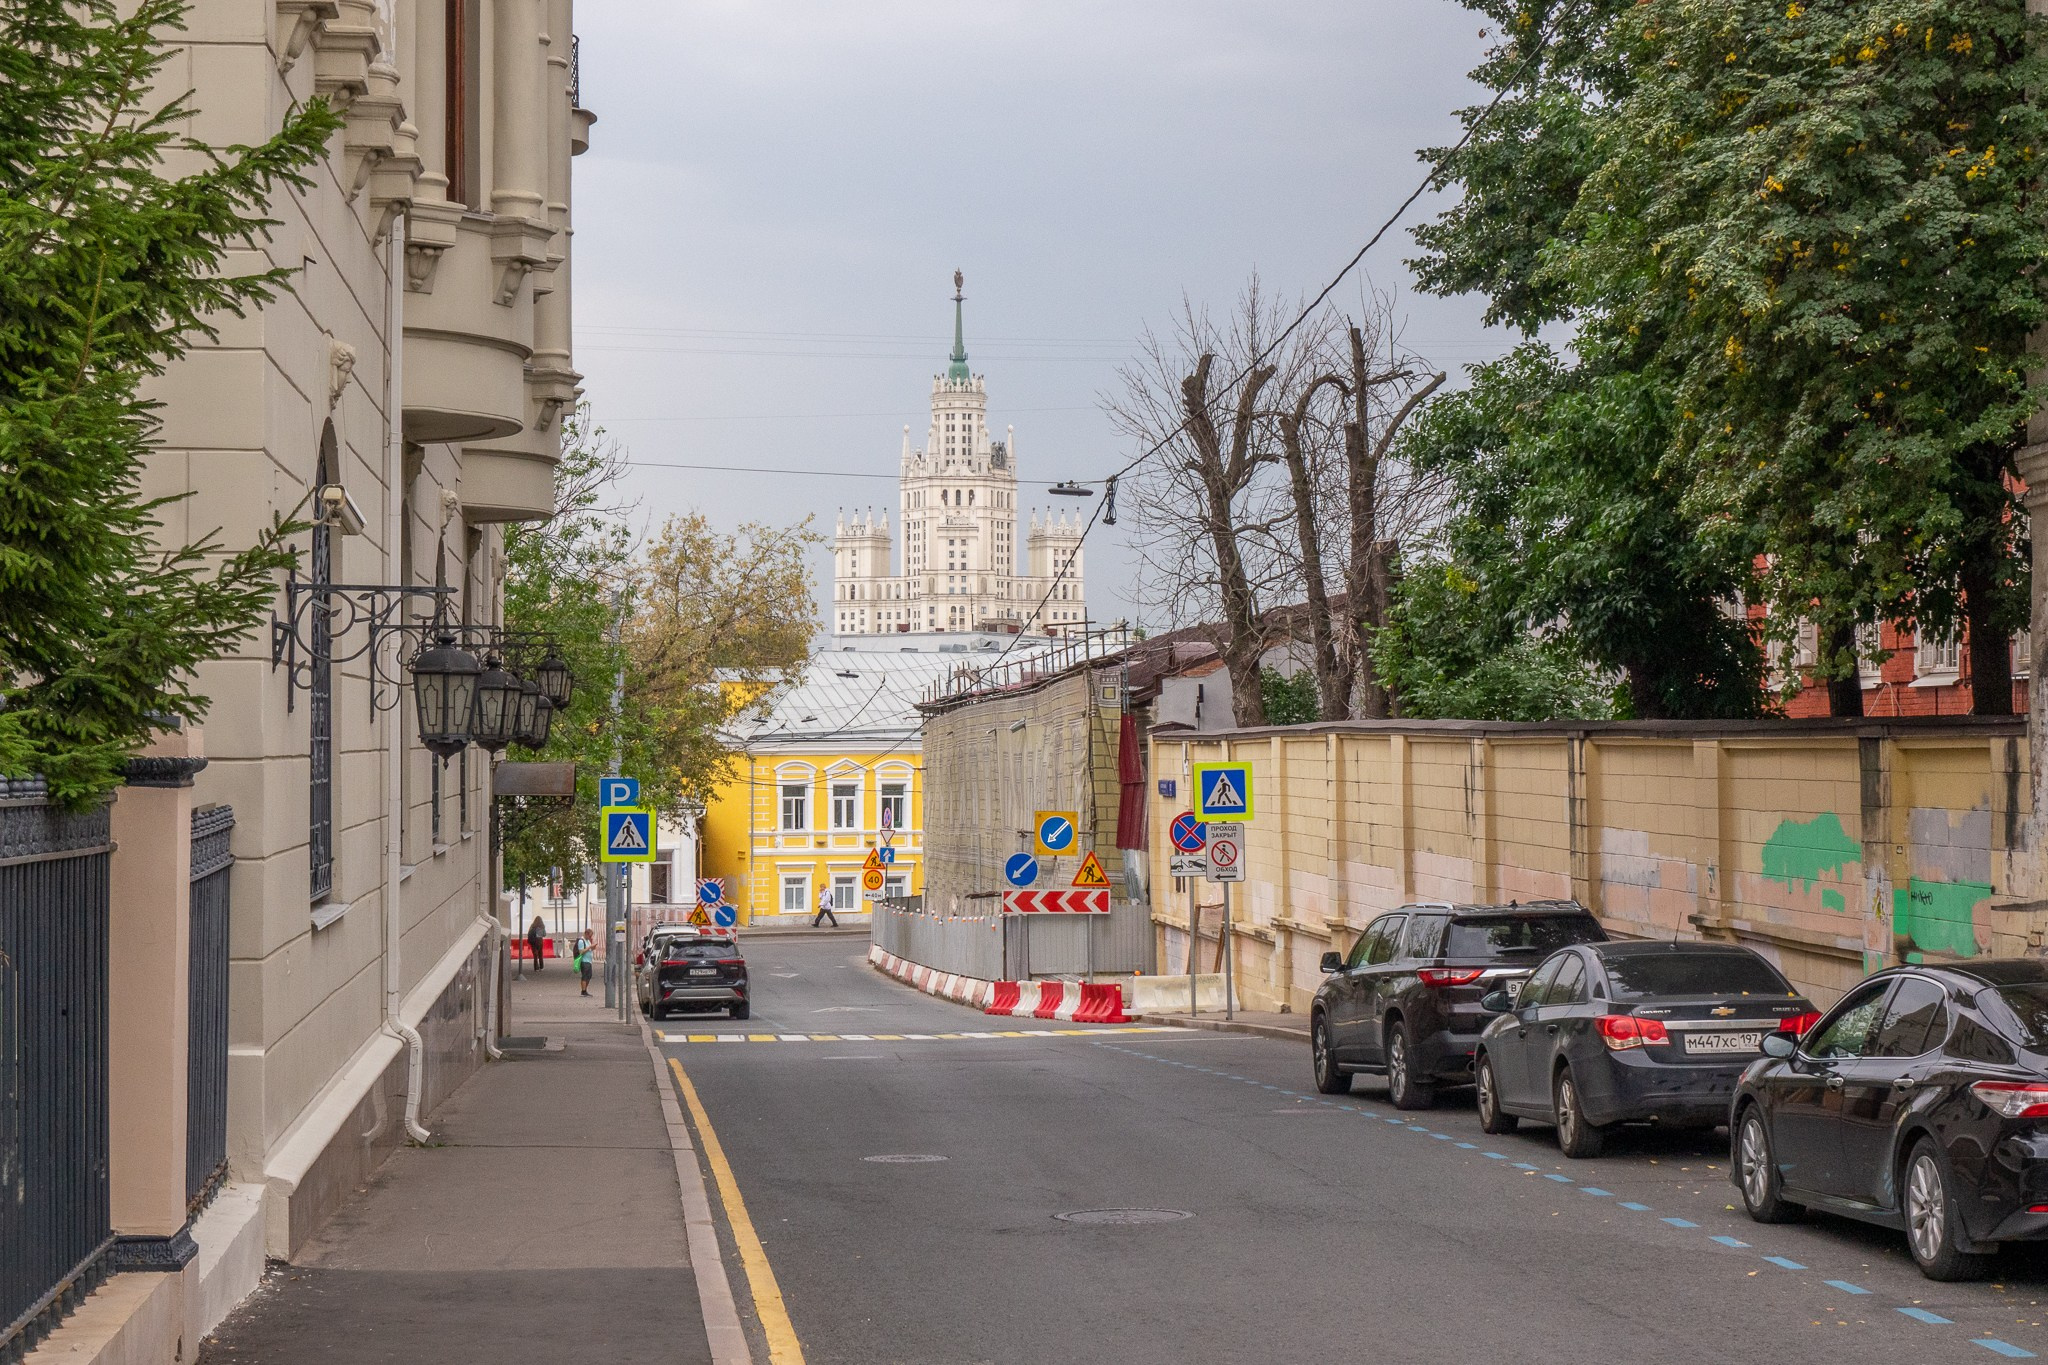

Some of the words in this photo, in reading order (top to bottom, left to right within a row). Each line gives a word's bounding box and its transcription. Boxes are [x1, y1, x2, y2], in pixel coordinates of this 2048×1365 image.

[610, 783, 631, 806] P
[868, 876, 880, 884] 40
[1687, 1035, 1738, 1049] М447ХС
[1740, 1033, 1758, 1044] 197
